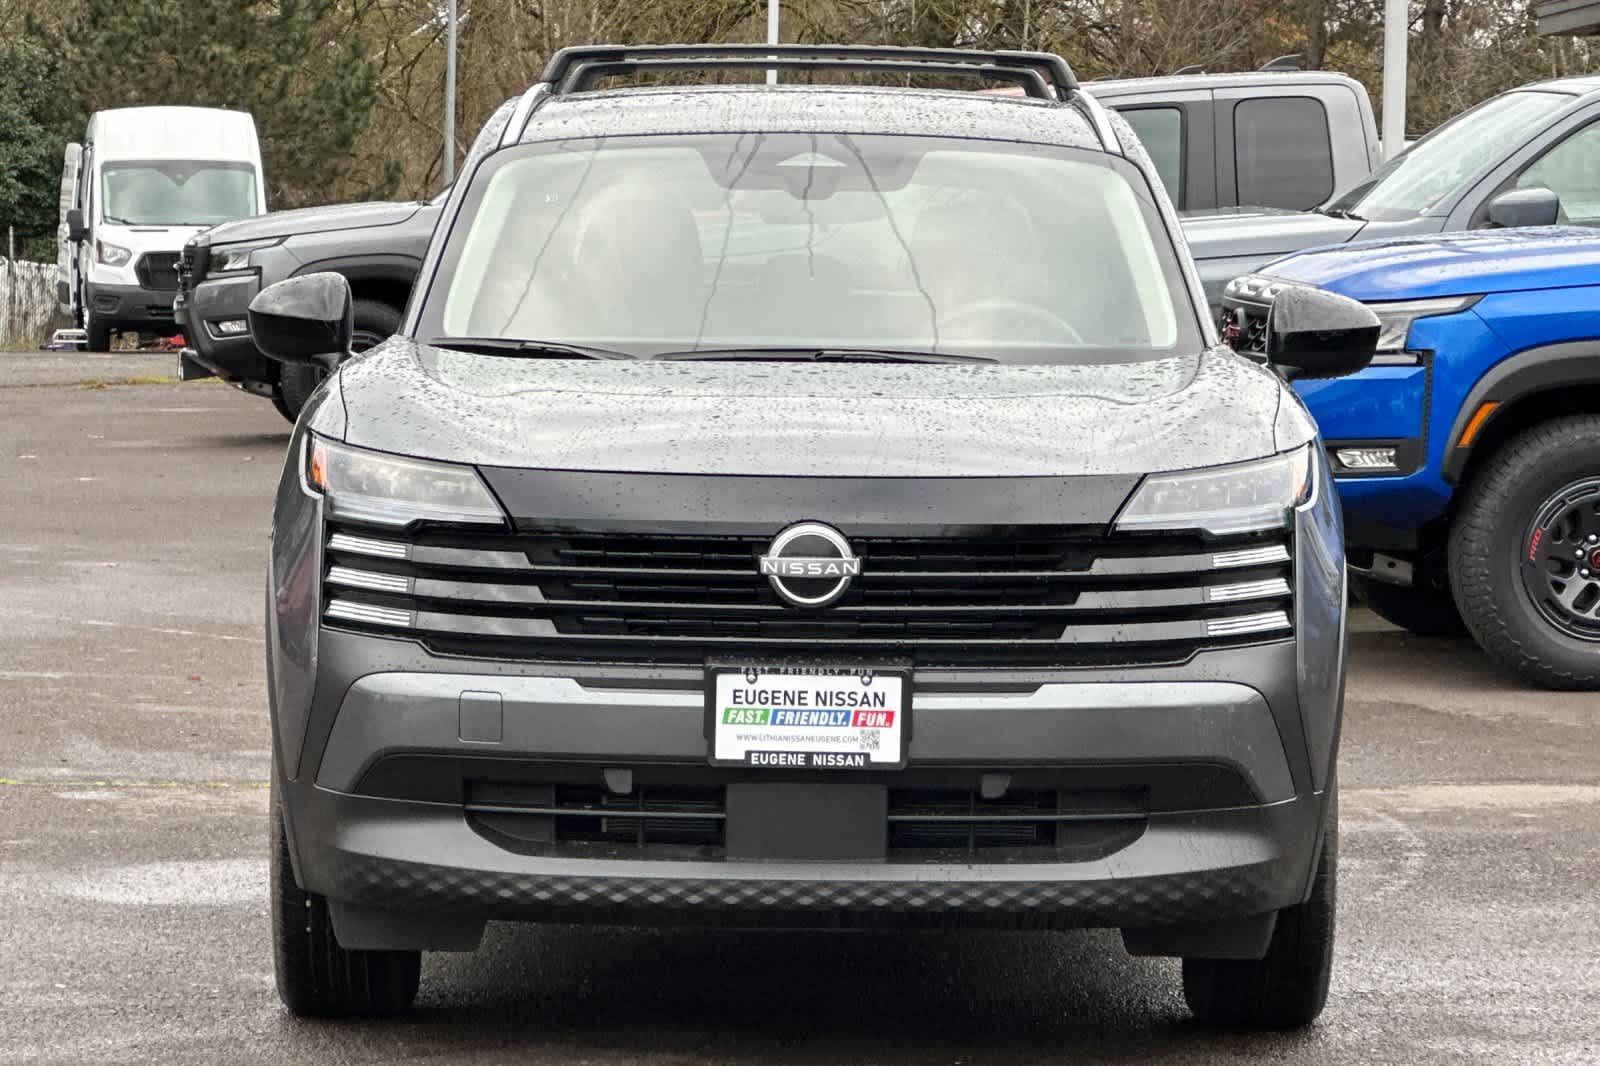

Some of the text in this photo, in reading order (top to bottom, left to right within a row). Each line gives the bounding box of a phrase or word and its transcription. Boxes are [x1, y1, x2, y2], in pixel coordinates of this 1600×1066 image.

[763, 561, 858, 575] NISSAN
[732, 689, 886, 707] EUGENE NISSAN
[728, 709, 890, 727] FAST. FRIENDLY. FUN.
[751, 753, 864, 767] EUGENE NISSAN
